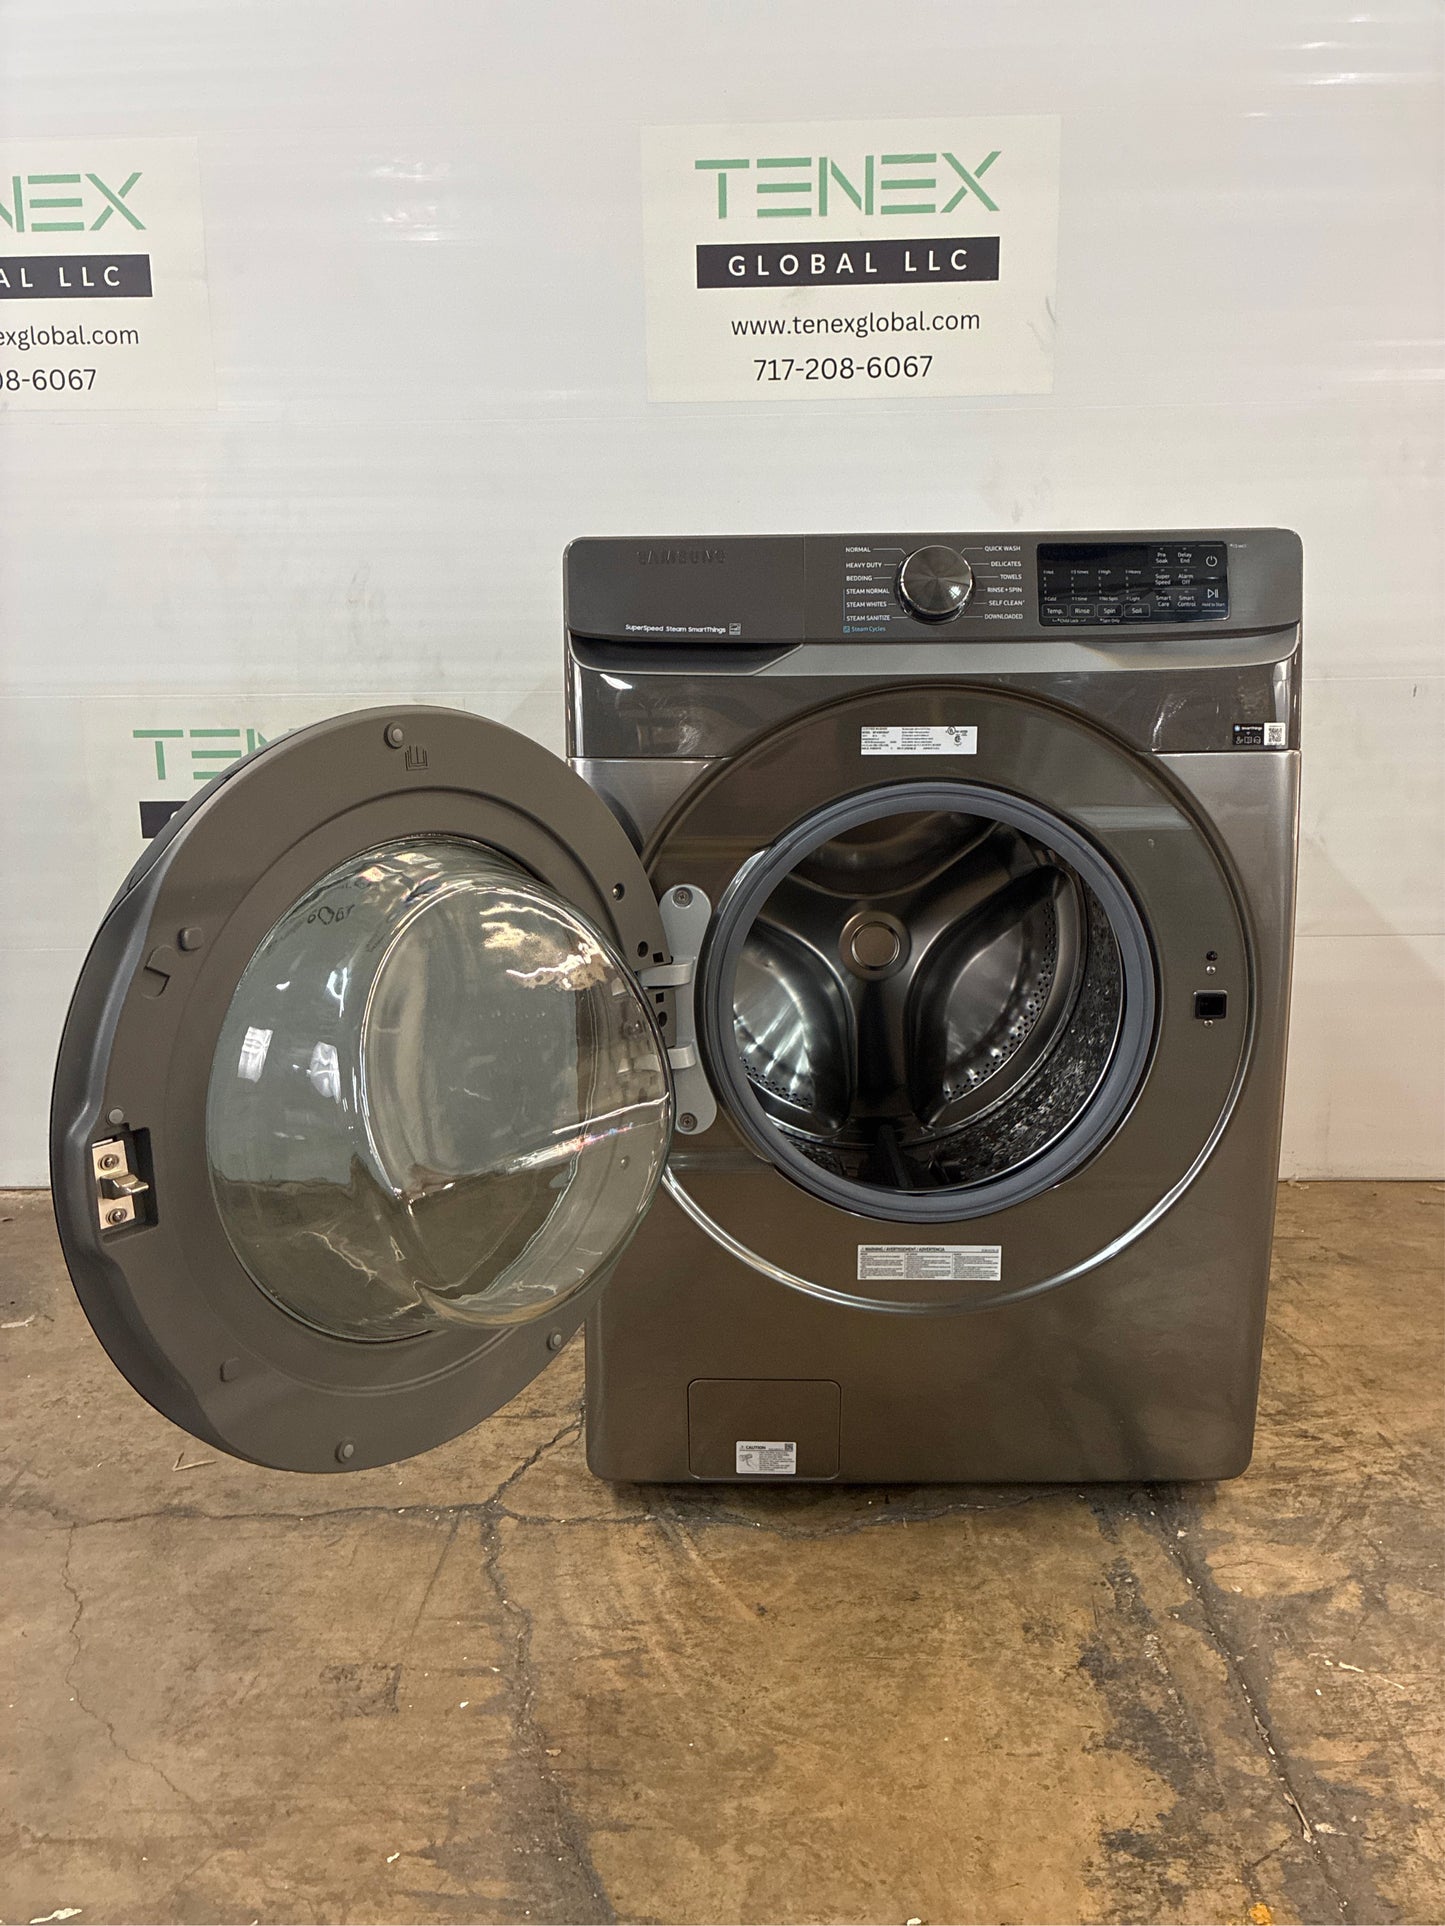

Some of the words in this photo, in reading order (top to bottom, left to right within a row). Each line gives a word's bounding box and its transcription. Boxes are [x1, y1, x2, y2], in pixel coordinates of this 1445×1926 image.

[694, 150, 1002, 220] TENEX
[728, 252, 878, 277] GLOBAL
[904, 248, 969, 272] LLC
[58, 265, 121, 287] LLC
[731, 311, 981, 338] www.tenexglobal.com
[0, 369, 97, 391] 8-6067
[753, 355, 933, 382] 717-208-6067
[637, 549, 726, 565] SAMSUNG
[625, 623, 664, 633] SuperSpeed
[665, 625, 687, 633] Steam
[688, 626, 726, 635] SmartThings
